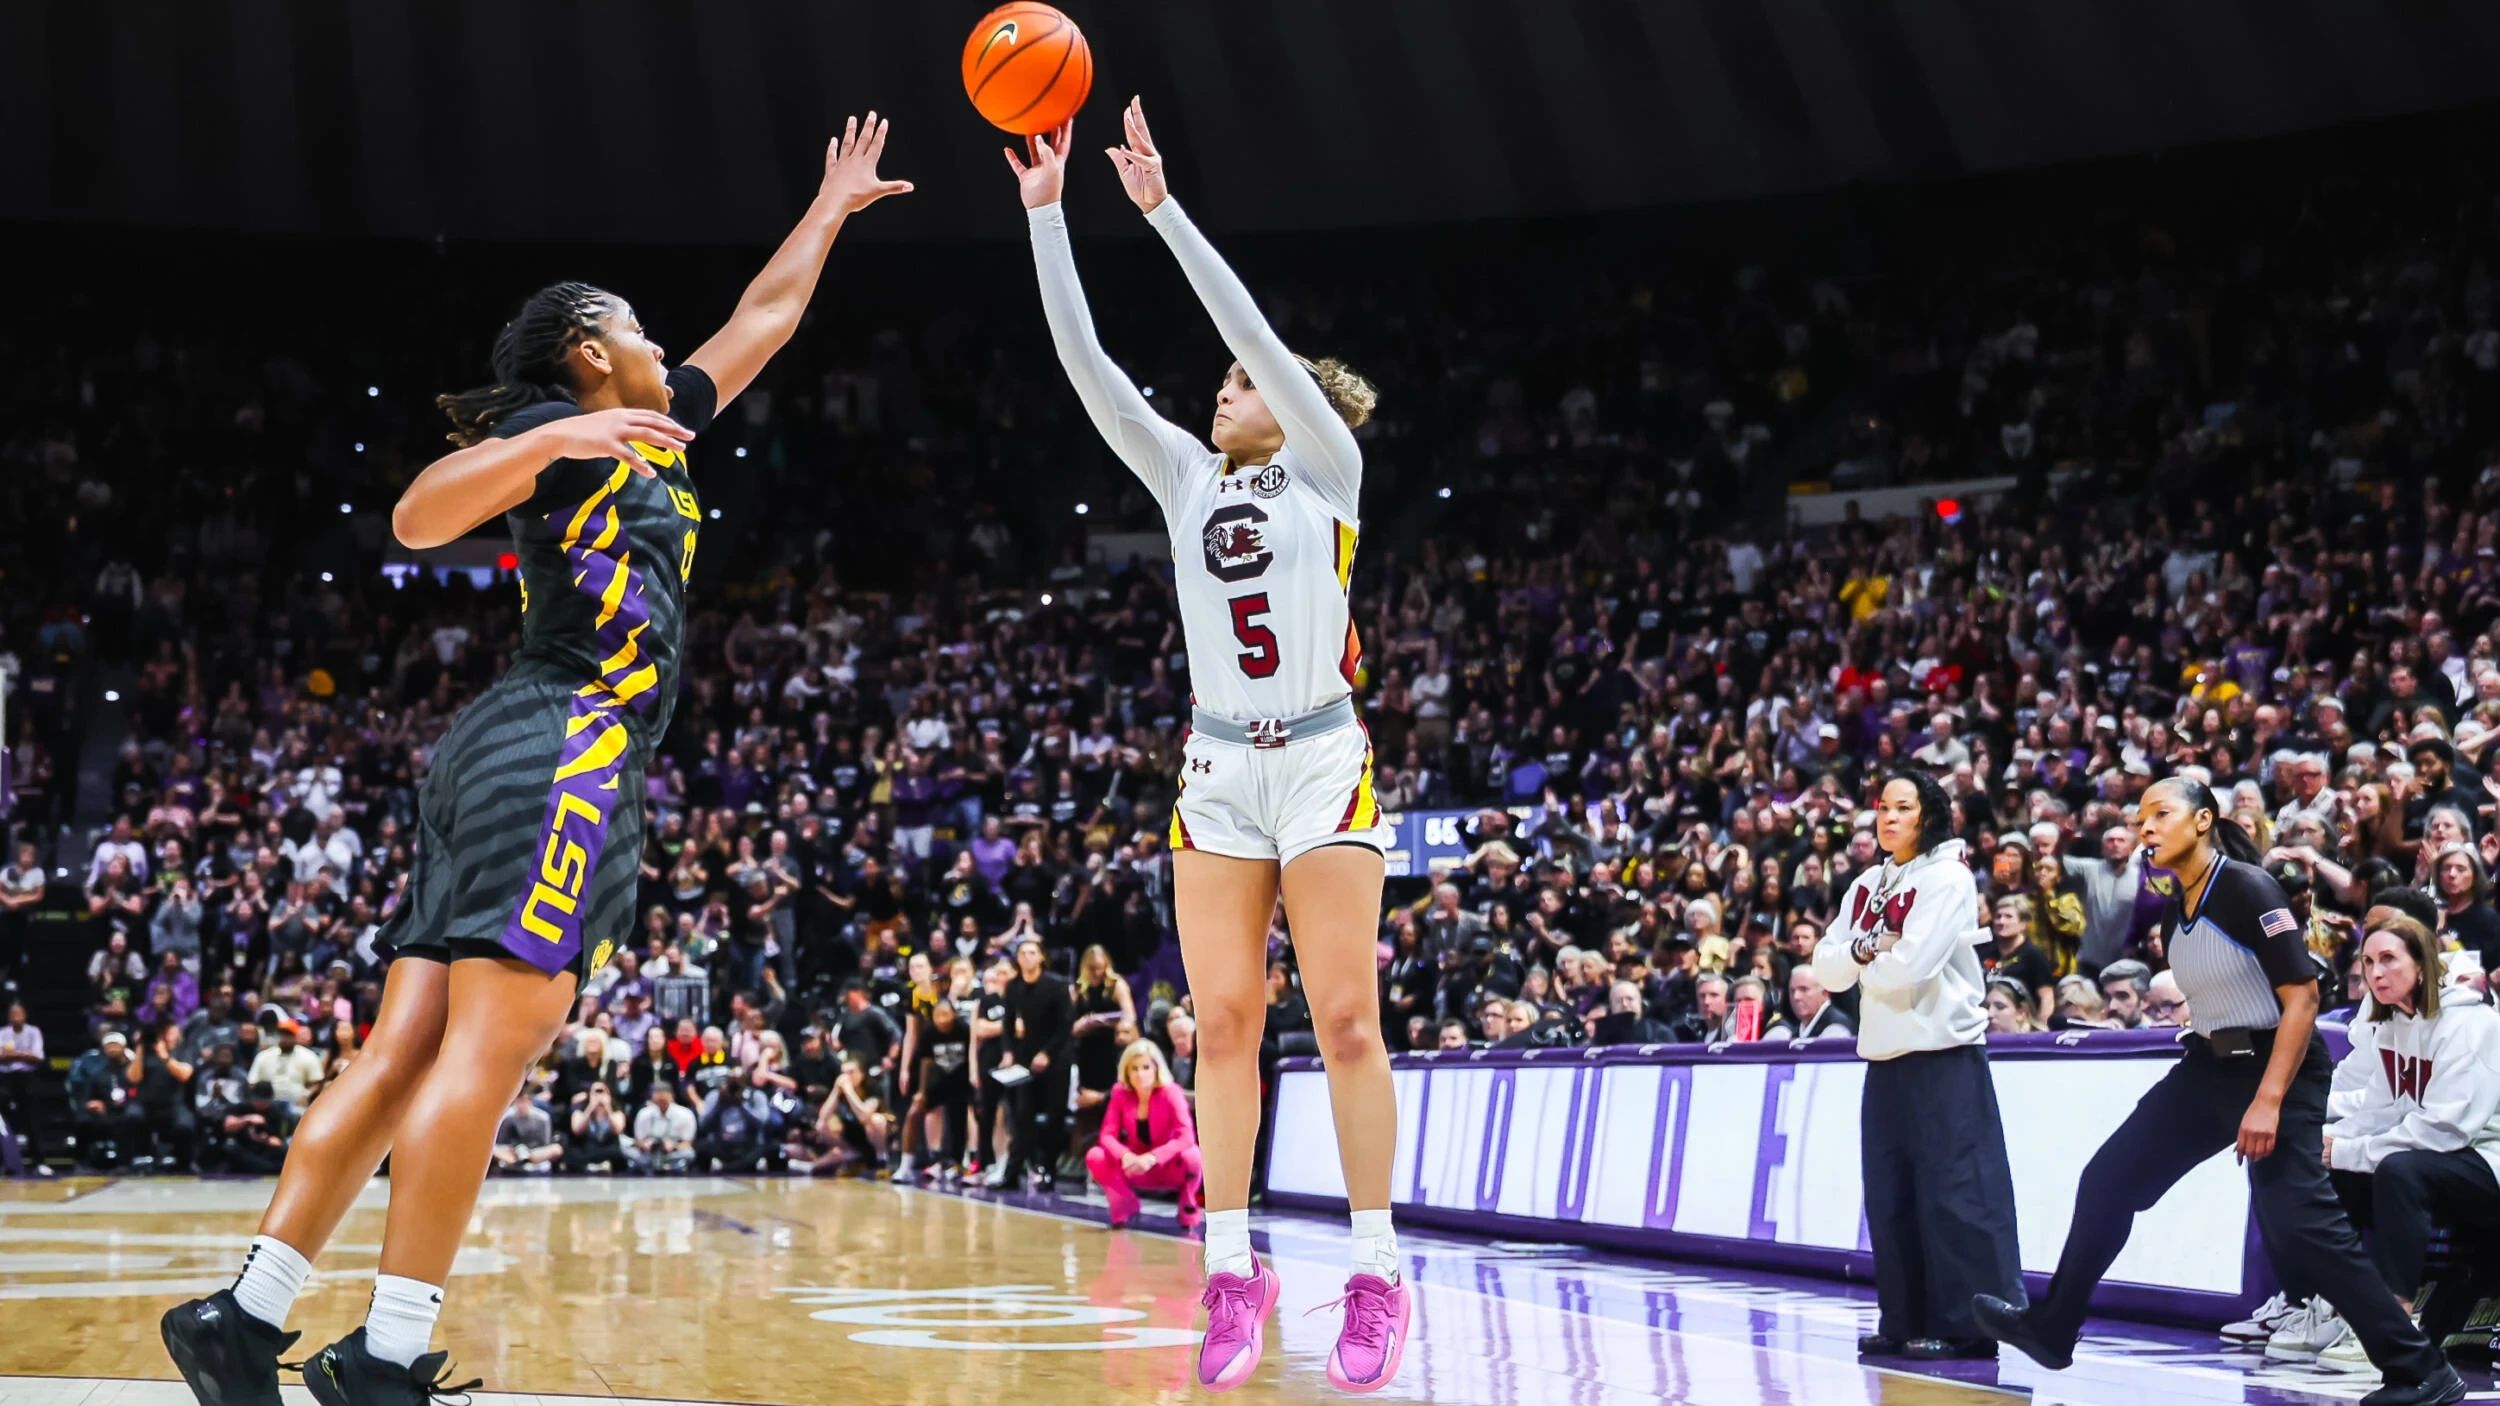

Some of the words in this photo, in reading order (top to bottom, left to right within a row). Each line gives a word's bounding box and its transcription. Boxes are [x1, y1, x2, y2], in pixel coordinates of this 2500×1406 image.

[1260, 466, 1284, 490] SEC
[1228, 591, 1280, 680] 5
[520, 791, 601, 945] LSU
